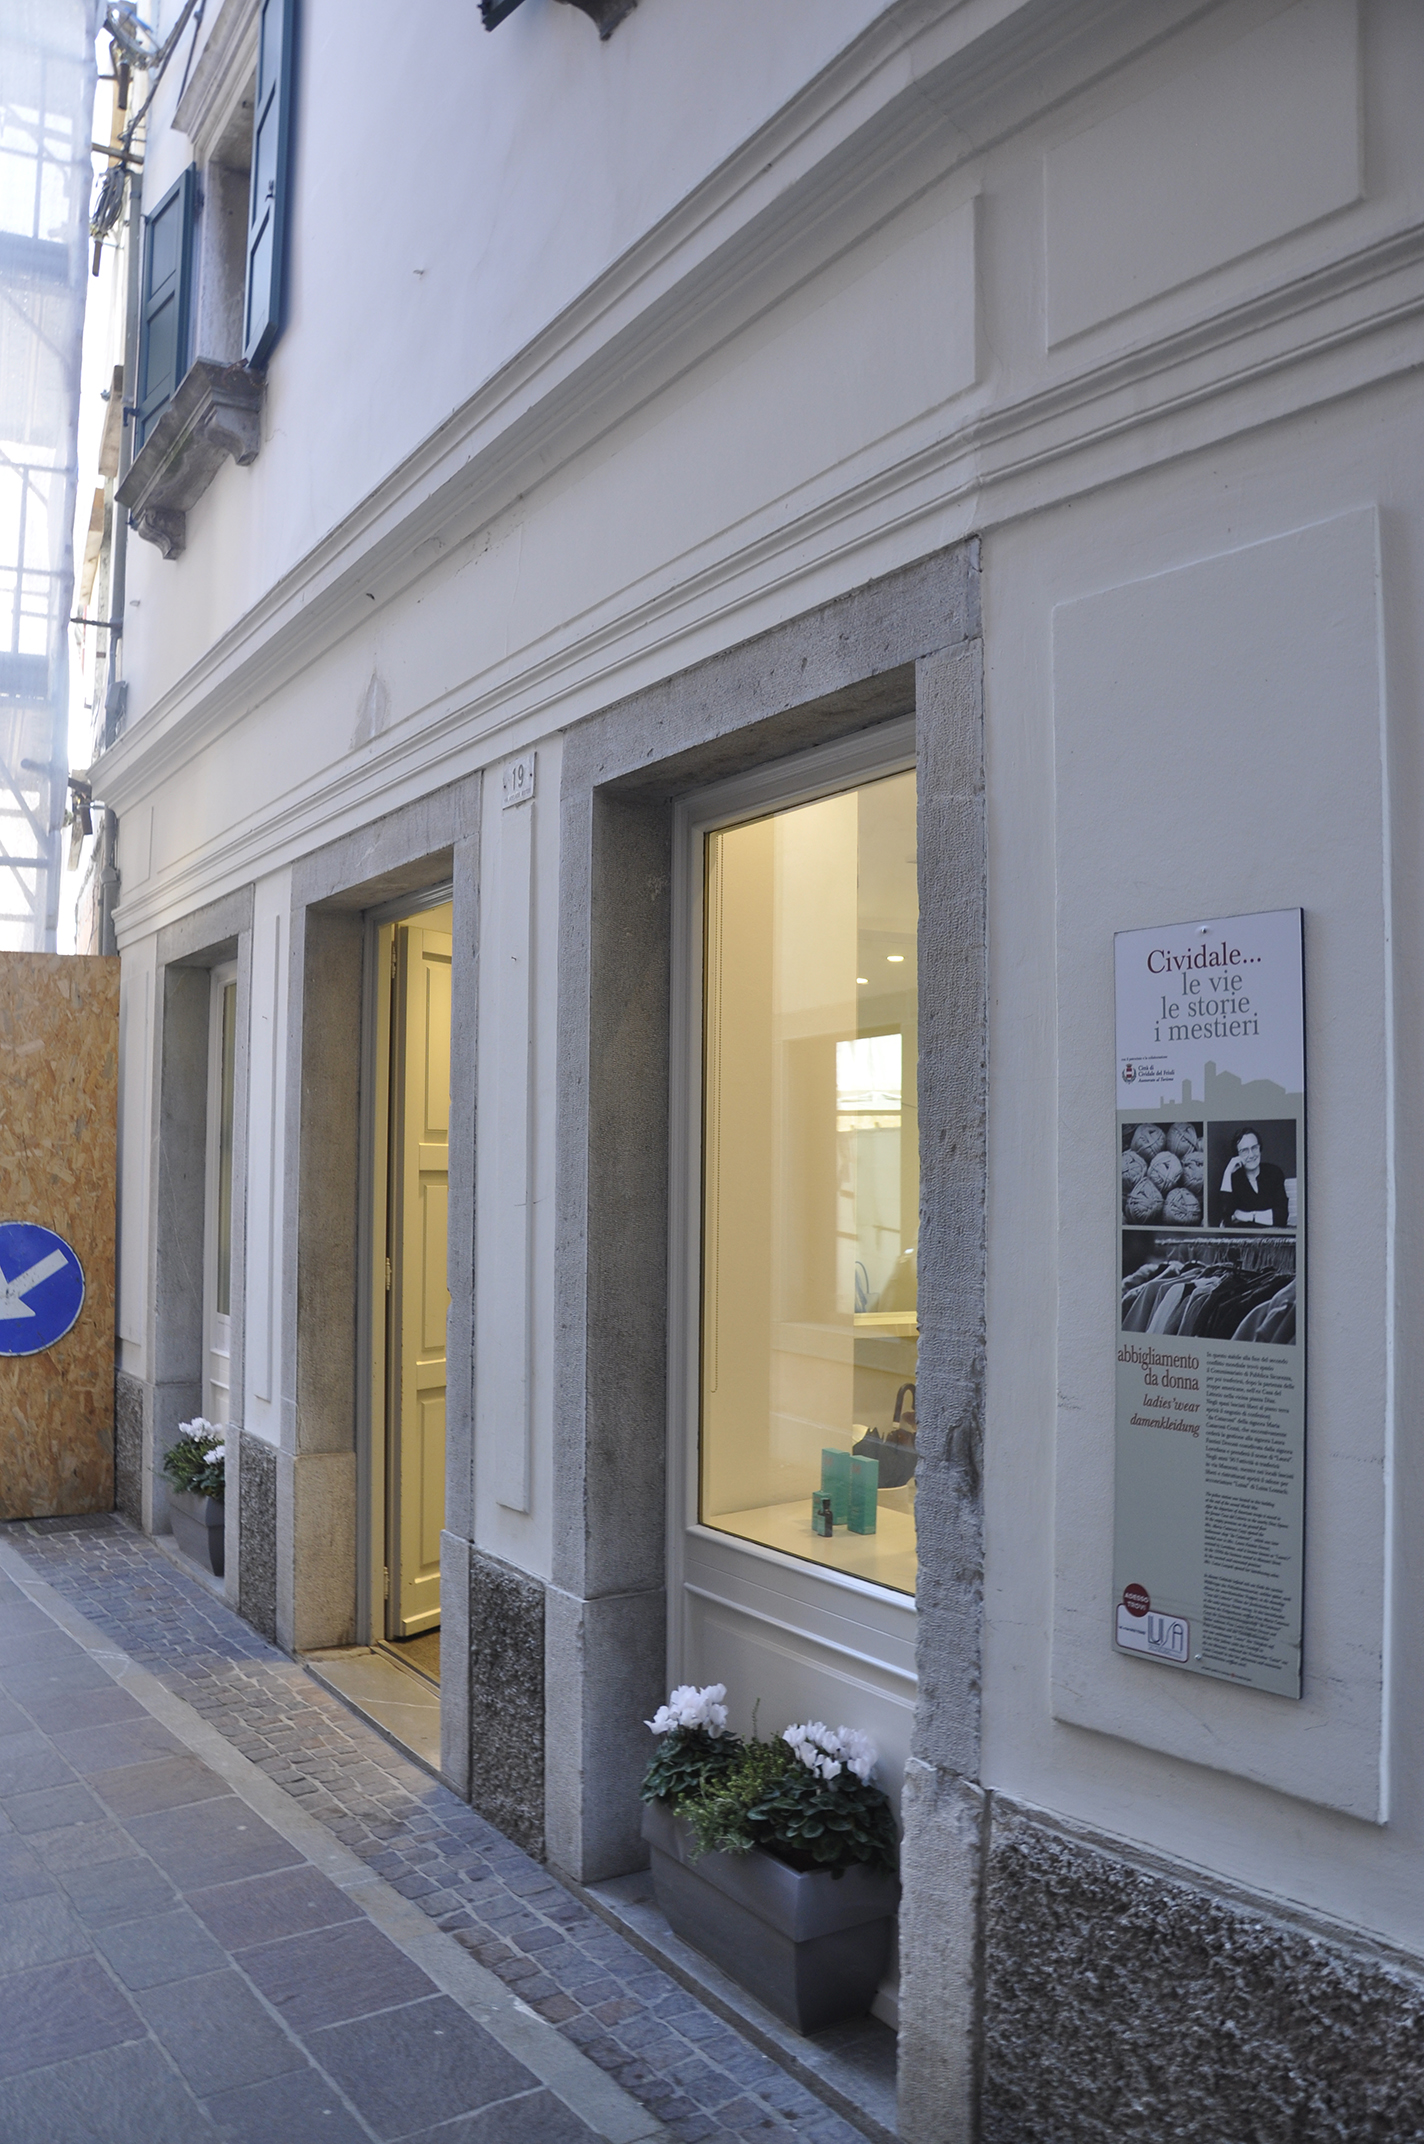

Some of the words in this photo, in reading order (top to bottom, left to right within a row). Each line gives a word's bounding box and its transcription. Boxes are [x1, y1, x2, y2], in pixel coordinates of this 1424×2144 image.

[512, 764, 524, 791] 19
[1146, 942, 1262, 974] Cividale...
[1182, 972, 1200, 996] le
[1208, 970, 1242, 992] vie
[1160, 996, 1180, 1020] le
[1188, 992, 1250, 1018] storie
[1154, 1020, 1161, 1042] i
[1168, 1012, 1260, 1041] mestieri
[1118, 1345, 1200, 1370] abbigliamento
[1144, 1368, 1158, 1386] da
[1161, 1369, 1199, 1390] donna
[1130, 1413, 1200, 1438] damenkleidung
